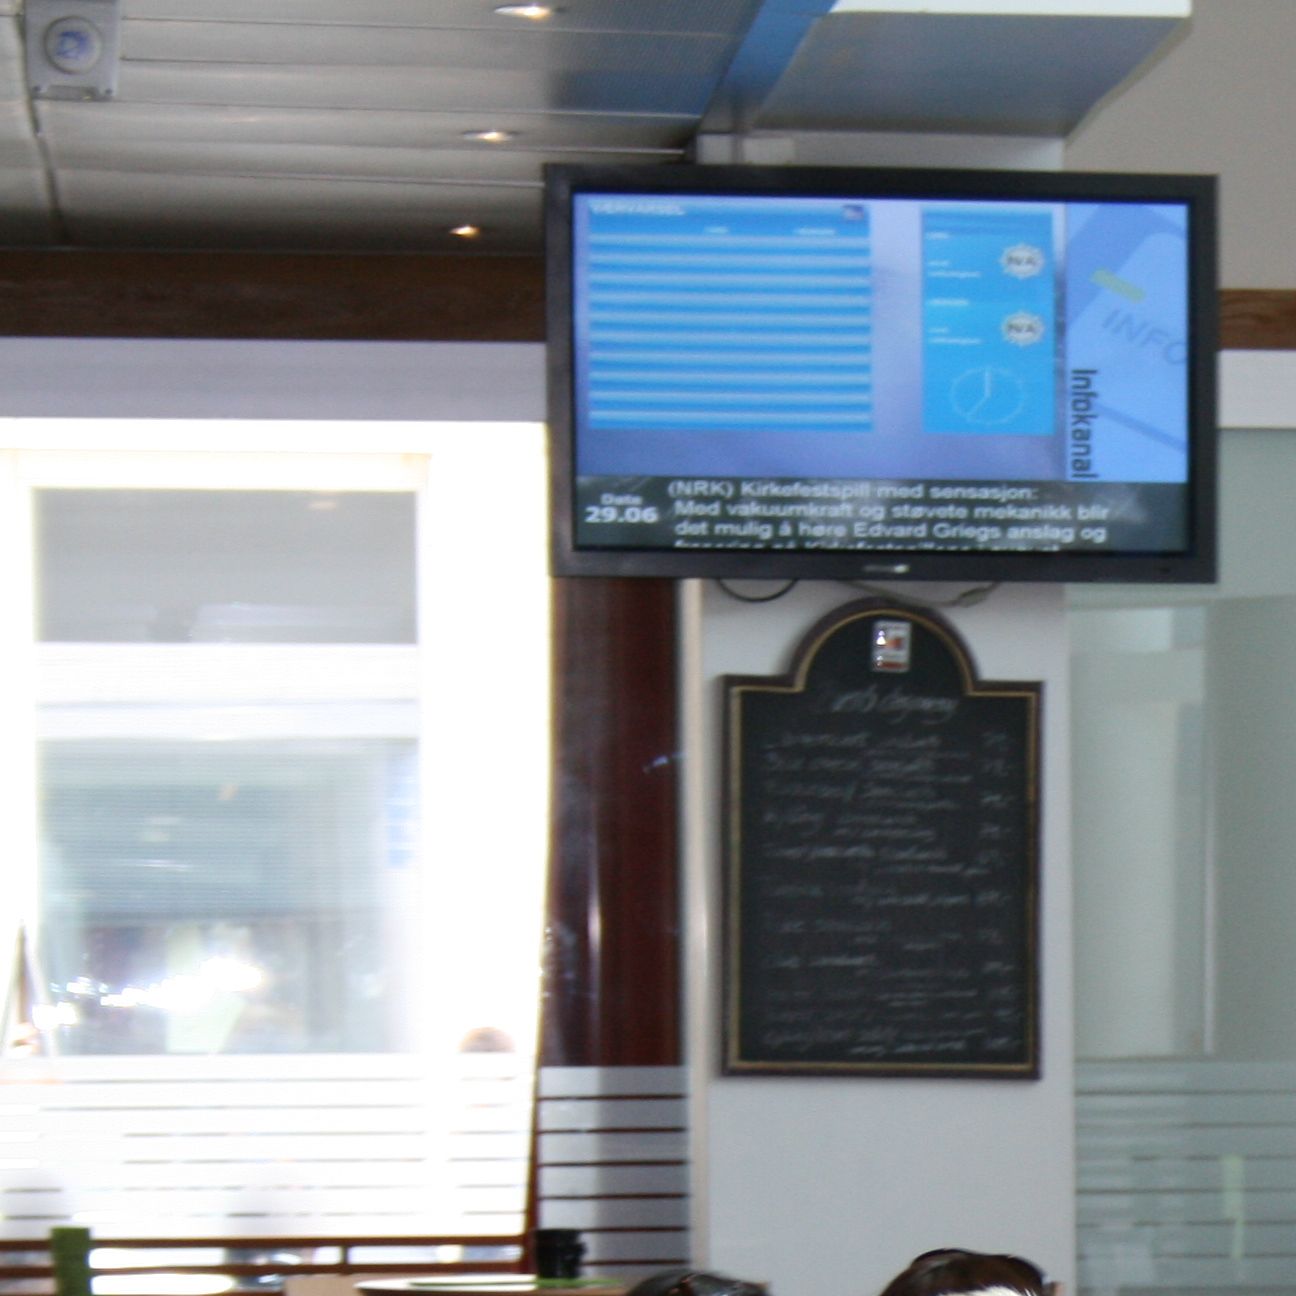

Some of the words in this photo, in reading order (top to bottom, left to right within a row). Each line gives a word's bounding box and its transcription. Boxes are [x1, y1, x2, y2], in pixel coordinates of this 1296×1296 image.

[1071, 368, 1098, 479] Infokanal
[668, 480, 734, 498] (NRK)
[741, 480, 870, 500] Kirkefestspill
[877, 485, 924, 499] med
[930, 486, 1038, 502] sensasjon:
[585, 506, 659, 523] 29.06
[675, 501, 721, 516] Med
[726, 501, 853, 518] vakuumkraft
[859, 505, 885, 520] og
[892, 504, 968, 520] støvete
[974, 505, 1071, 521] mekanikk
[1077, 506, 1109, 520] blir
[675, 520, 709, 536] det
[714, 520, 773, 540] mulig
[799, 522, 846, 537] høre
[854, 522, 927, 538] Edvard
[933, 523, 1000, 542] Griegs
[1006, 525, 1075, 544] anslag
[1080, 527, 1107, 543] og
